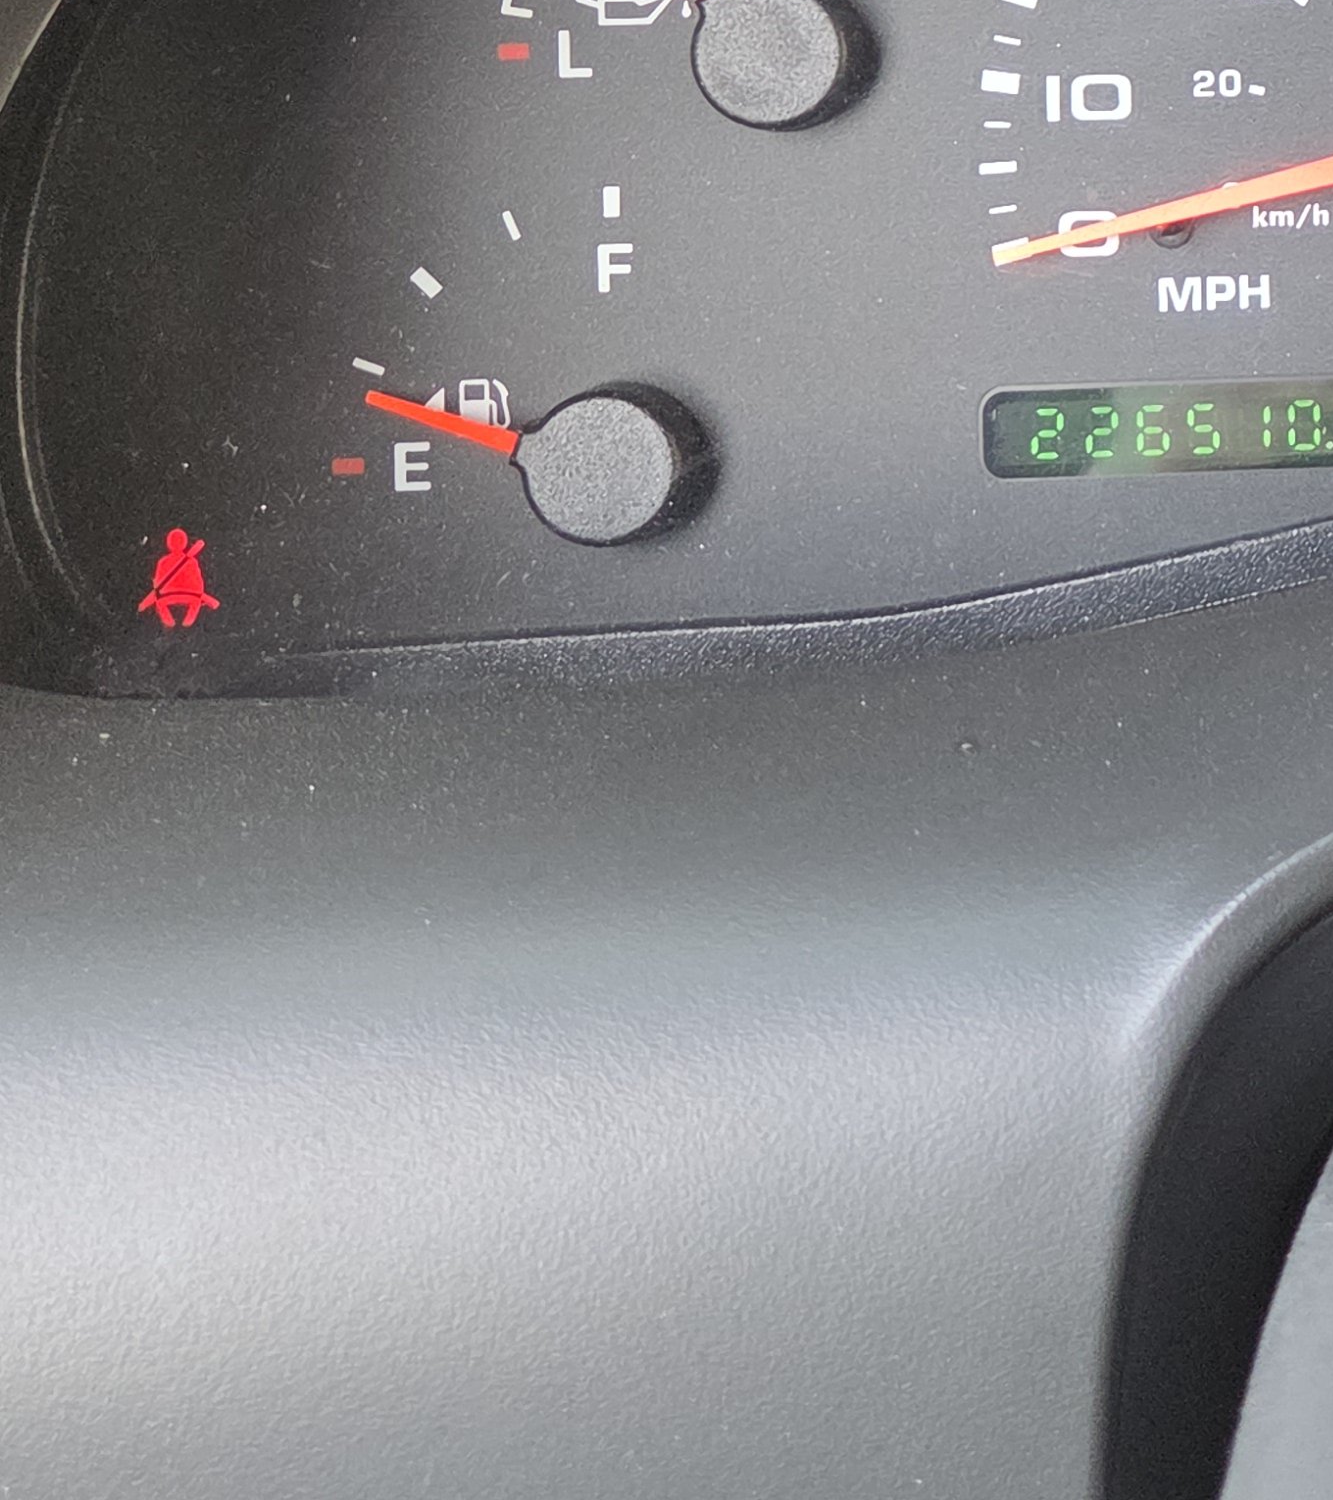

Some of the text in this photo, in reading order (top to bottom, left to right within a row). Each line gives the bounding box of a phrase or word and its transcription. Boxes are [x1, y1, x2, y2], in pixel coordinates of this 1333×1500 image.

[558, 30, 592, 78] L
[1046, 75, 1132, 122] 10
[1193, 69, 1241, 97] 20
[1058, 211, 1120, 257] 0
[1253, 203, 1329, 229] km/h
[597, 244, 633, 292] F
[1158, 275, 1270, 312] MPH
[394, 442, 431, 491] E
